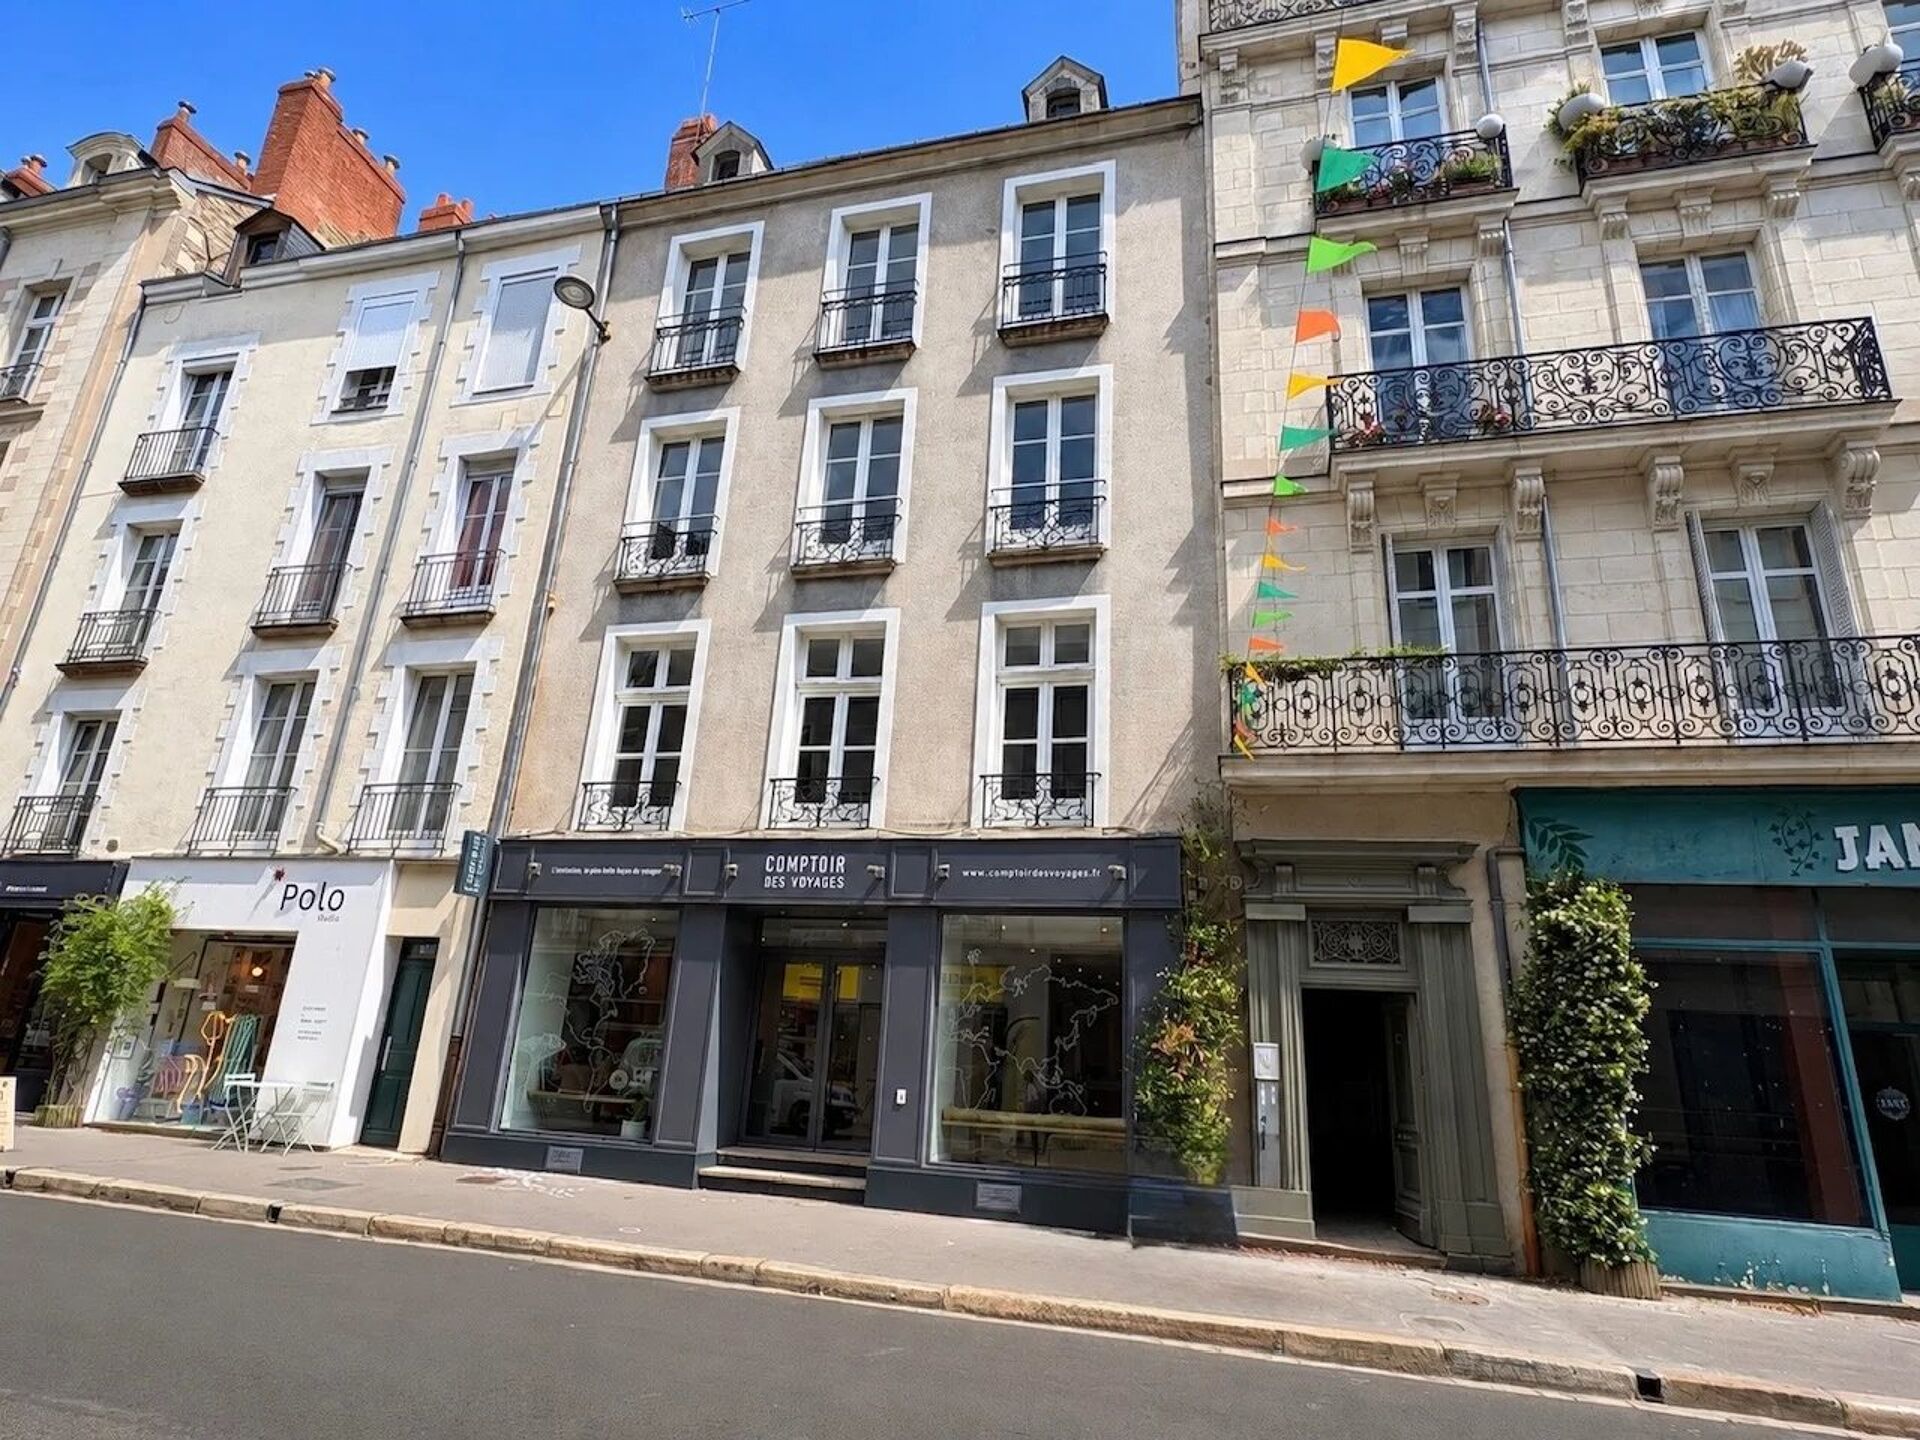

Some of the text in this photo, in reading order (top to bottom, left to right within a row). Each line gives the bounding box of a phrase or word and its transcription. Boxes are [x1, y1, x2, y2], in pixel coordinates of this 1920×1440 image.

[765, 855, 845, 873] COMPTOIR
[962, 867, 1100, 879] www.comptoirdesvoyages.fr
[764, 876, 845, 889] DES VOYAGES
[280, 881, 344, 911] Polo
